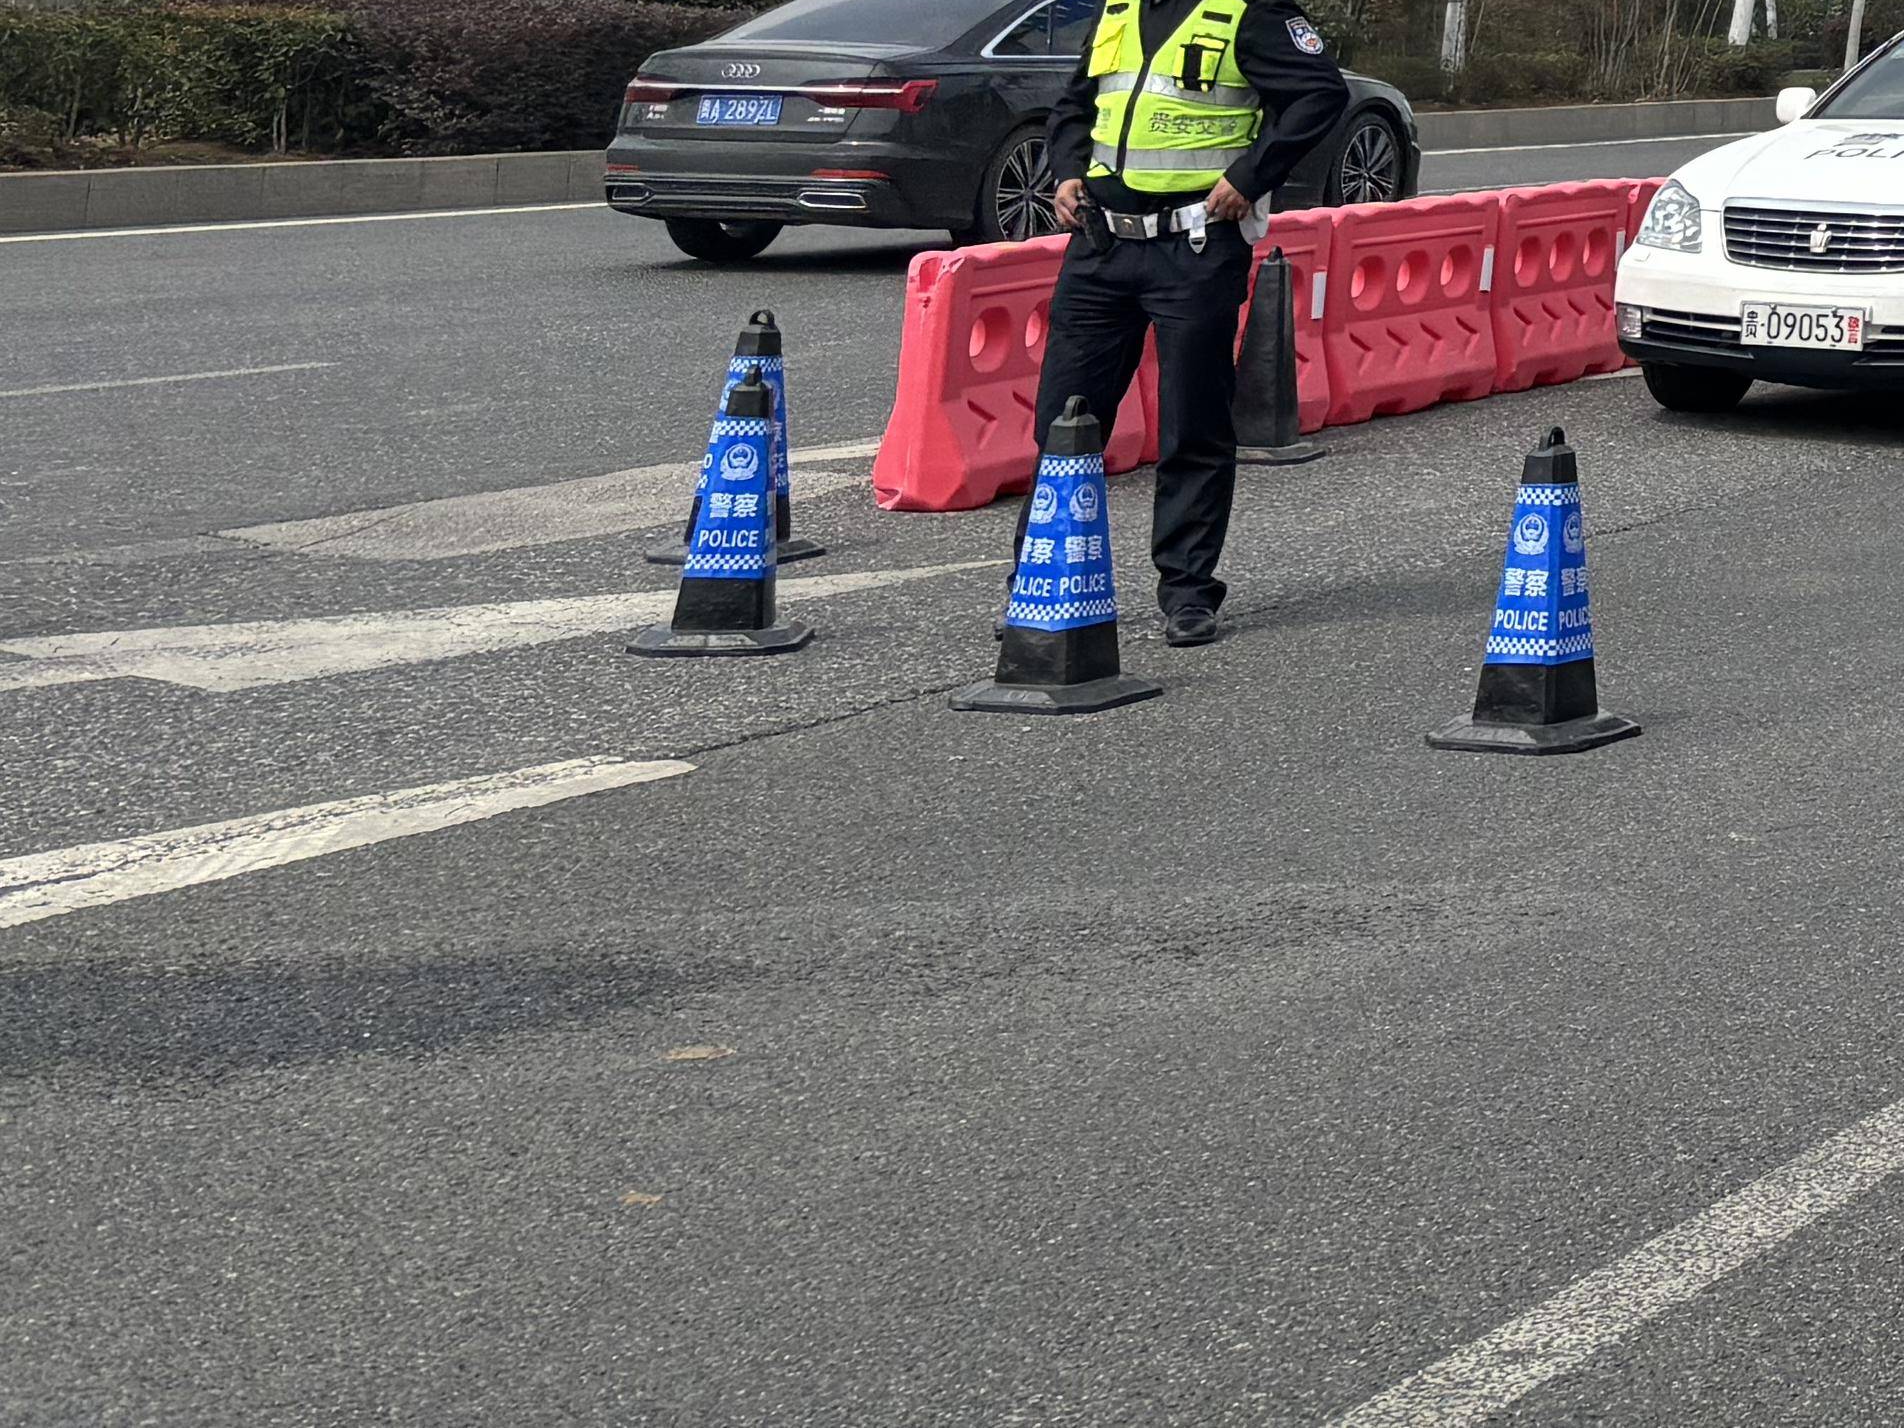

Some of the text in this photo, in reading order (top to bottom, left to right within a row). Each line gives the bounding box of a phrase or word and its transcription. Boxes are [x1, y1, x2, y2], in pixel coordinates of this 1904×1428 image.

[709, 492, 760, 520] 警察
[698, 529, 760, 549] POLICE
[1064, 535, 1103, 565] 警察
[1059, 573, 1106, 597] POLICE
[1504, 567, 1549, 597] 警察
[1494, 608, 1549, 632] POLICE
